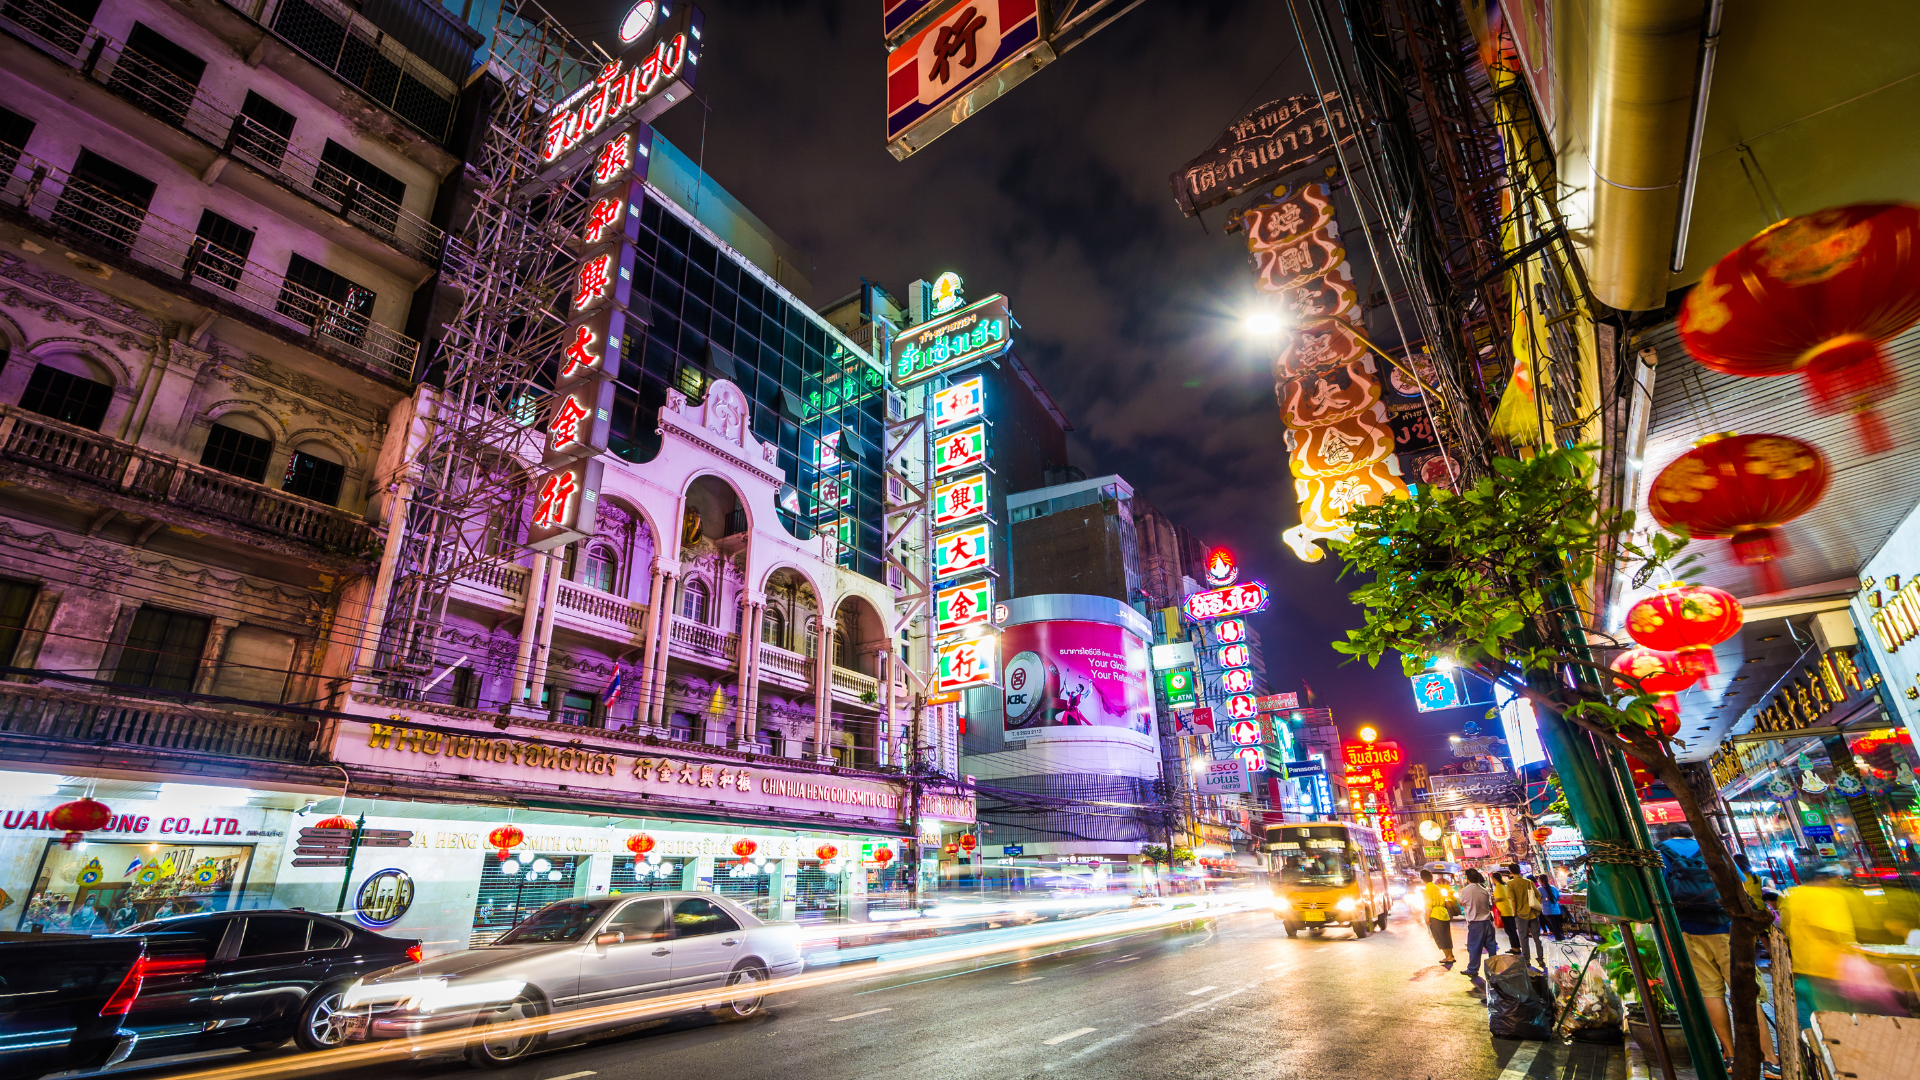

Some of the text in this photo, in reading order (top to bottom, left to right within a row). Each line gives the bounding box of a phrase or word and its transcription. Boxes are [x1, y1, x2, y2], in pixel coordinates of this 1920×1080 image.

[929, 6, 987, 85] 行
[919, 314, 977, 344] ห้างขายทอง
[947, 390, 976, 678] 和成興大金行
[1088, 658, 1108, 668] Your
[1091, 669, 1111, 680] Your
[1007, 694, 1027, 705] ICBC
[1424, 681, 1444, 702] 行
[1258, 694, 1298, 710] รงรับจำนำ
[1195, 712, 1209, 722] KFC
[1206, 763, 1238, 772] TESCO
[1288, 764, 1321, 776] Panasonic
[1206, 774, 1239, 785] Lotus
[761, 778, 785, 796] CHIN
[785, 781, 805, 798] HUA
[805, 785, 830, 801] HENG
[830, 788, 875, 807] GOLDSMITH
[160, 817, 241, 836] CO.,LTD.
[435, 832, 479, 850] HENG
[565, 837, 611, 853] CO.,LTD.
